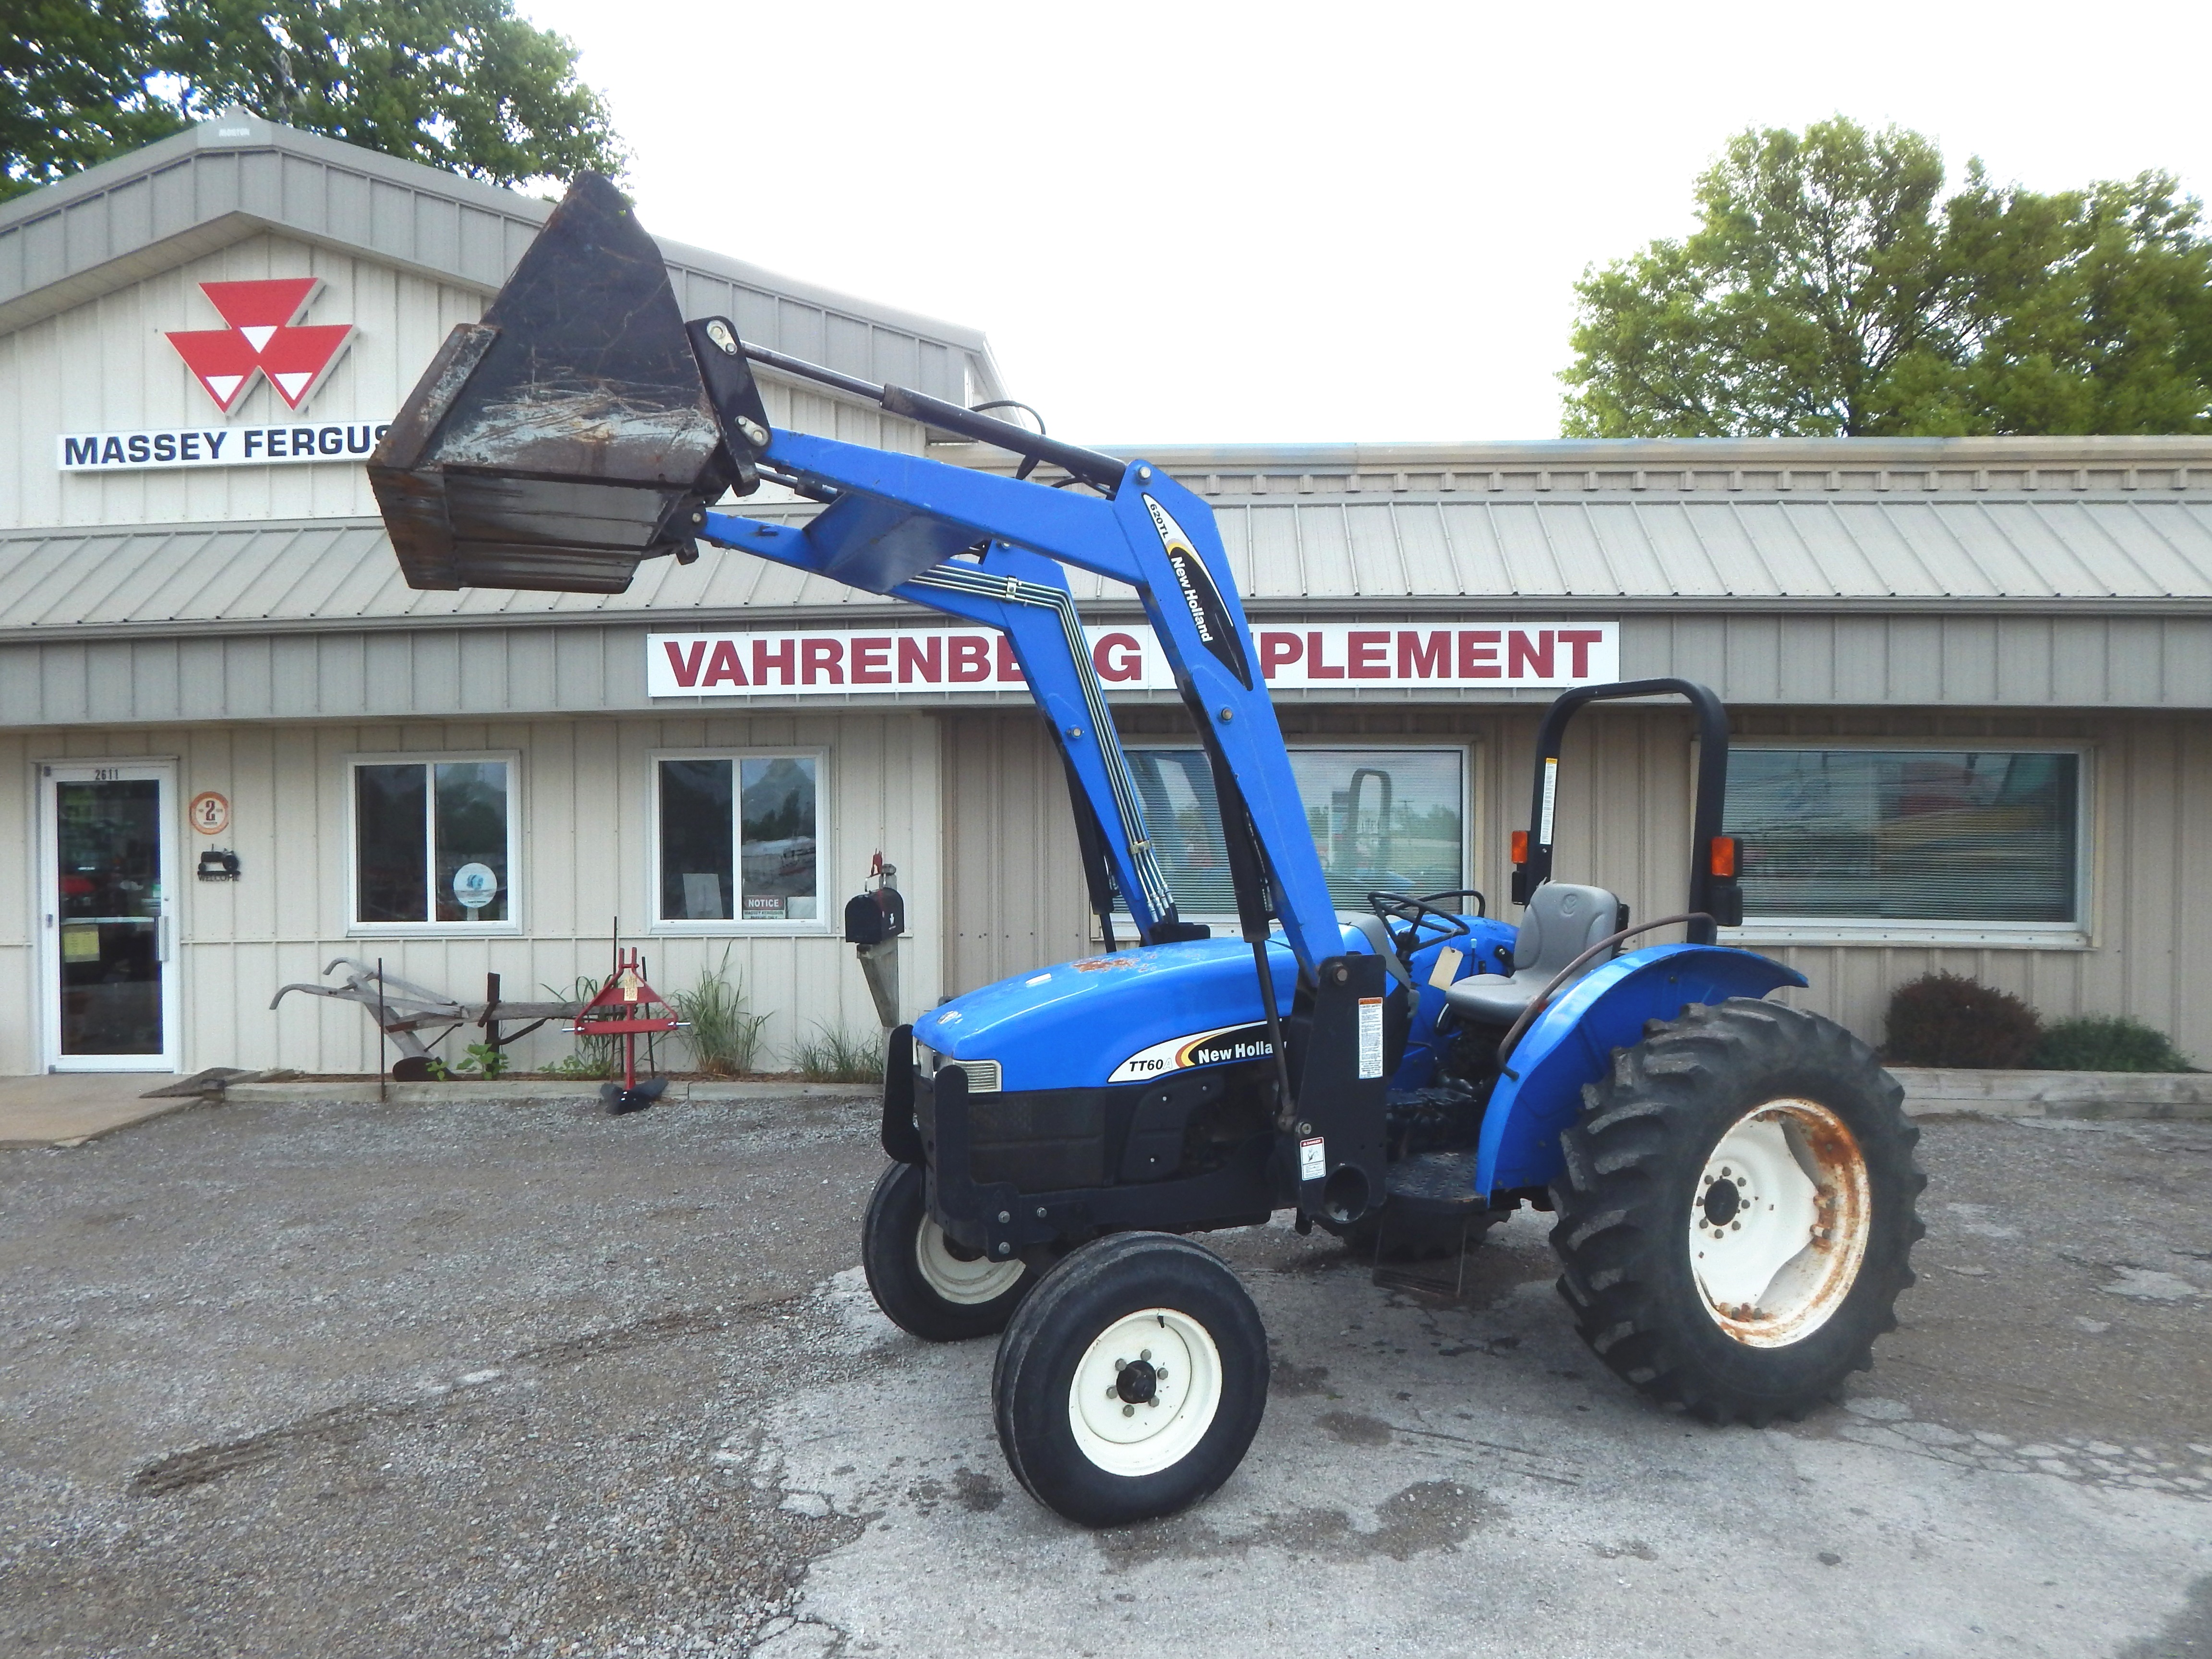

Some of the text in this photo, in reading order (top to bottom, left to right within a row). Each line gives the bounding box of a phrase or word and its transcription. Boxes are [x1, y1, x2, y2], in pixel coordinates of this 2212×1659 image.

[65, 424, 392, 465] MASSEY FERGUS
[1150, 504, 1169, 539] 620TL
[1171, 556, 1213, 642] New Holland
[663, 630, 1602, 687] VAHRENBEG PLEMENT
[96, 769, 118, 780] 2611
[205, 800, 216, 821] 2
[748, 899, 780, 908] NOTICE
[1198, 1041, 1287, 1064] New Holla
